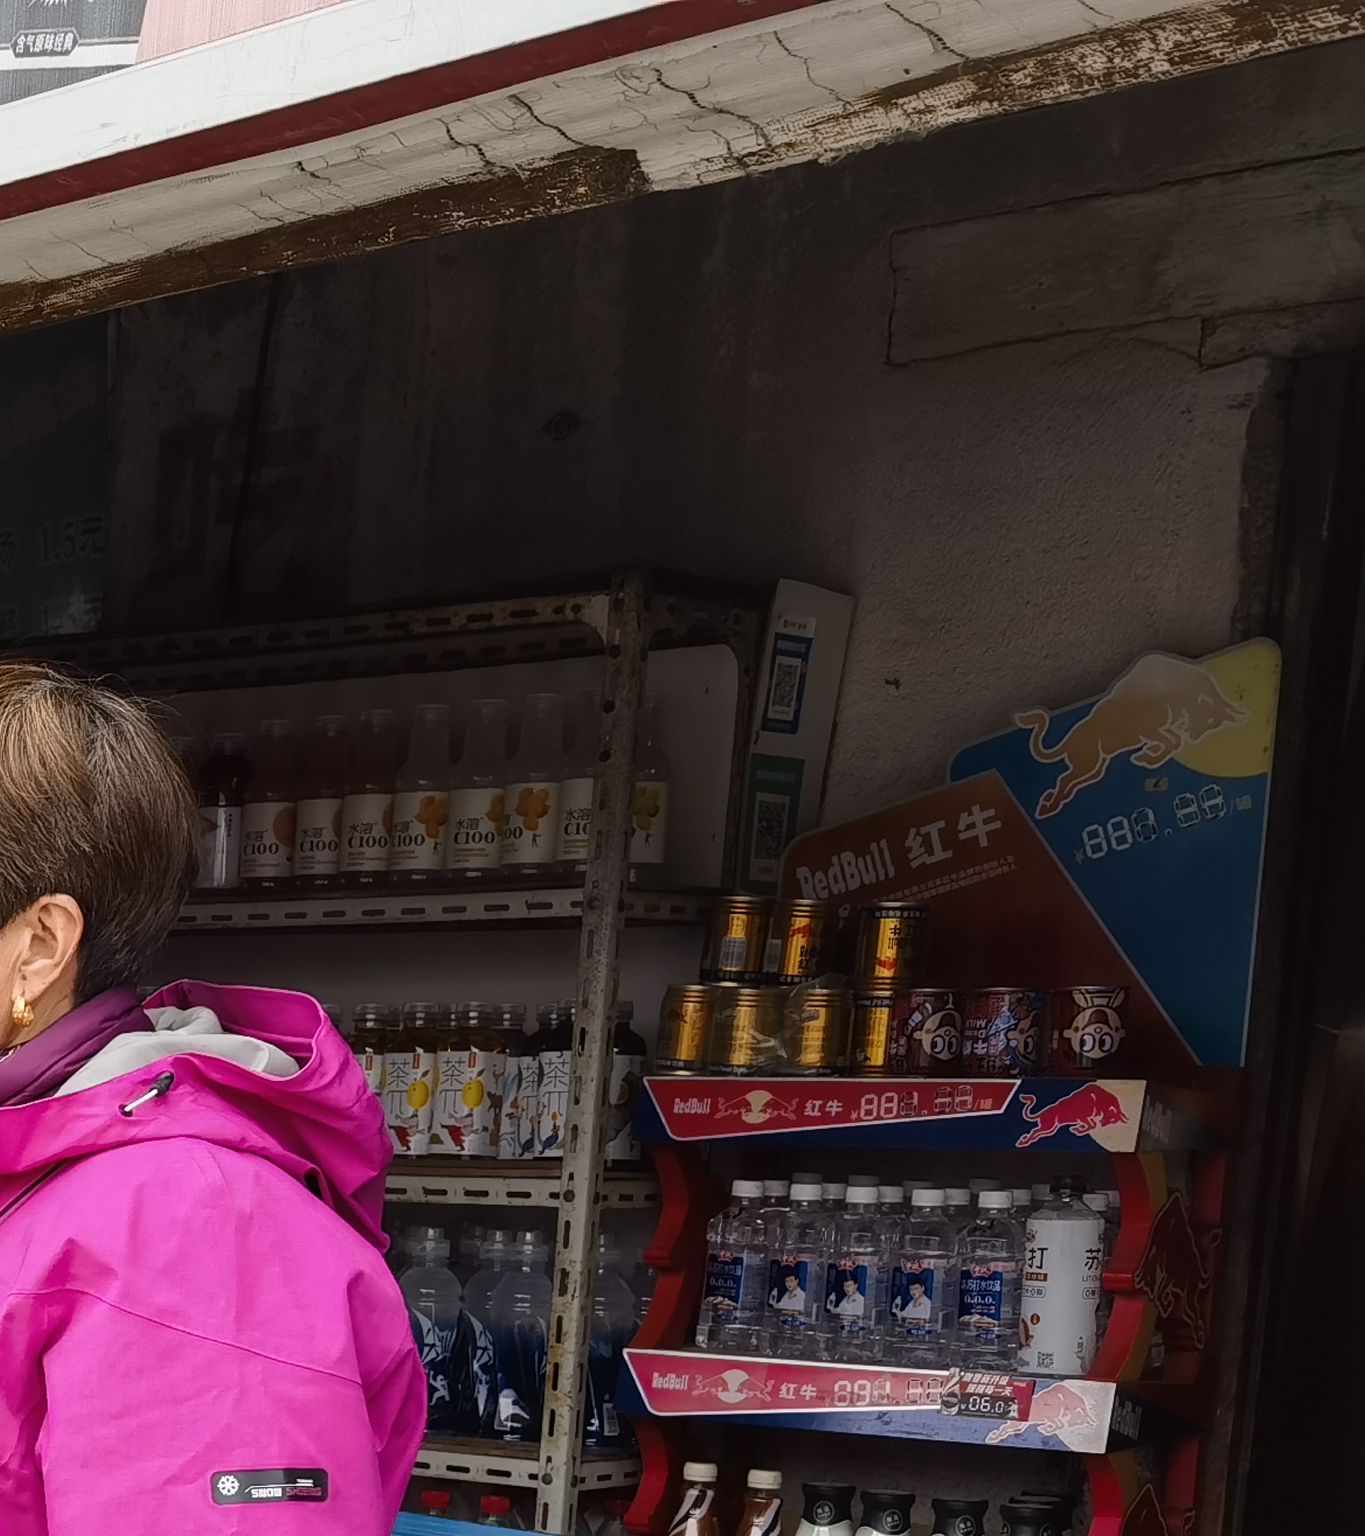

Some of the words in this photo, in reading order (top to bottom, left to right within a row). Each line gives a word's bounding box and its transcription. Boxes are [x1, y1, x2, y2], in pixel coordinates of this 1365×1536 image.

[300, 839, 339, 853] C100
[347, 835, 388, 849] C100
[454, 831, 495, 845] C100
[796, 838, 896, 898] RedBull
[904, 803, 1003, 869] 红牛
[673, 1098, 711, 1116] RedBull
[803, 1099, 843, 1117] 红牛
[651, 1373, 690, 1391] RedBull
[779, 1382, 818, 1401] 红牛
